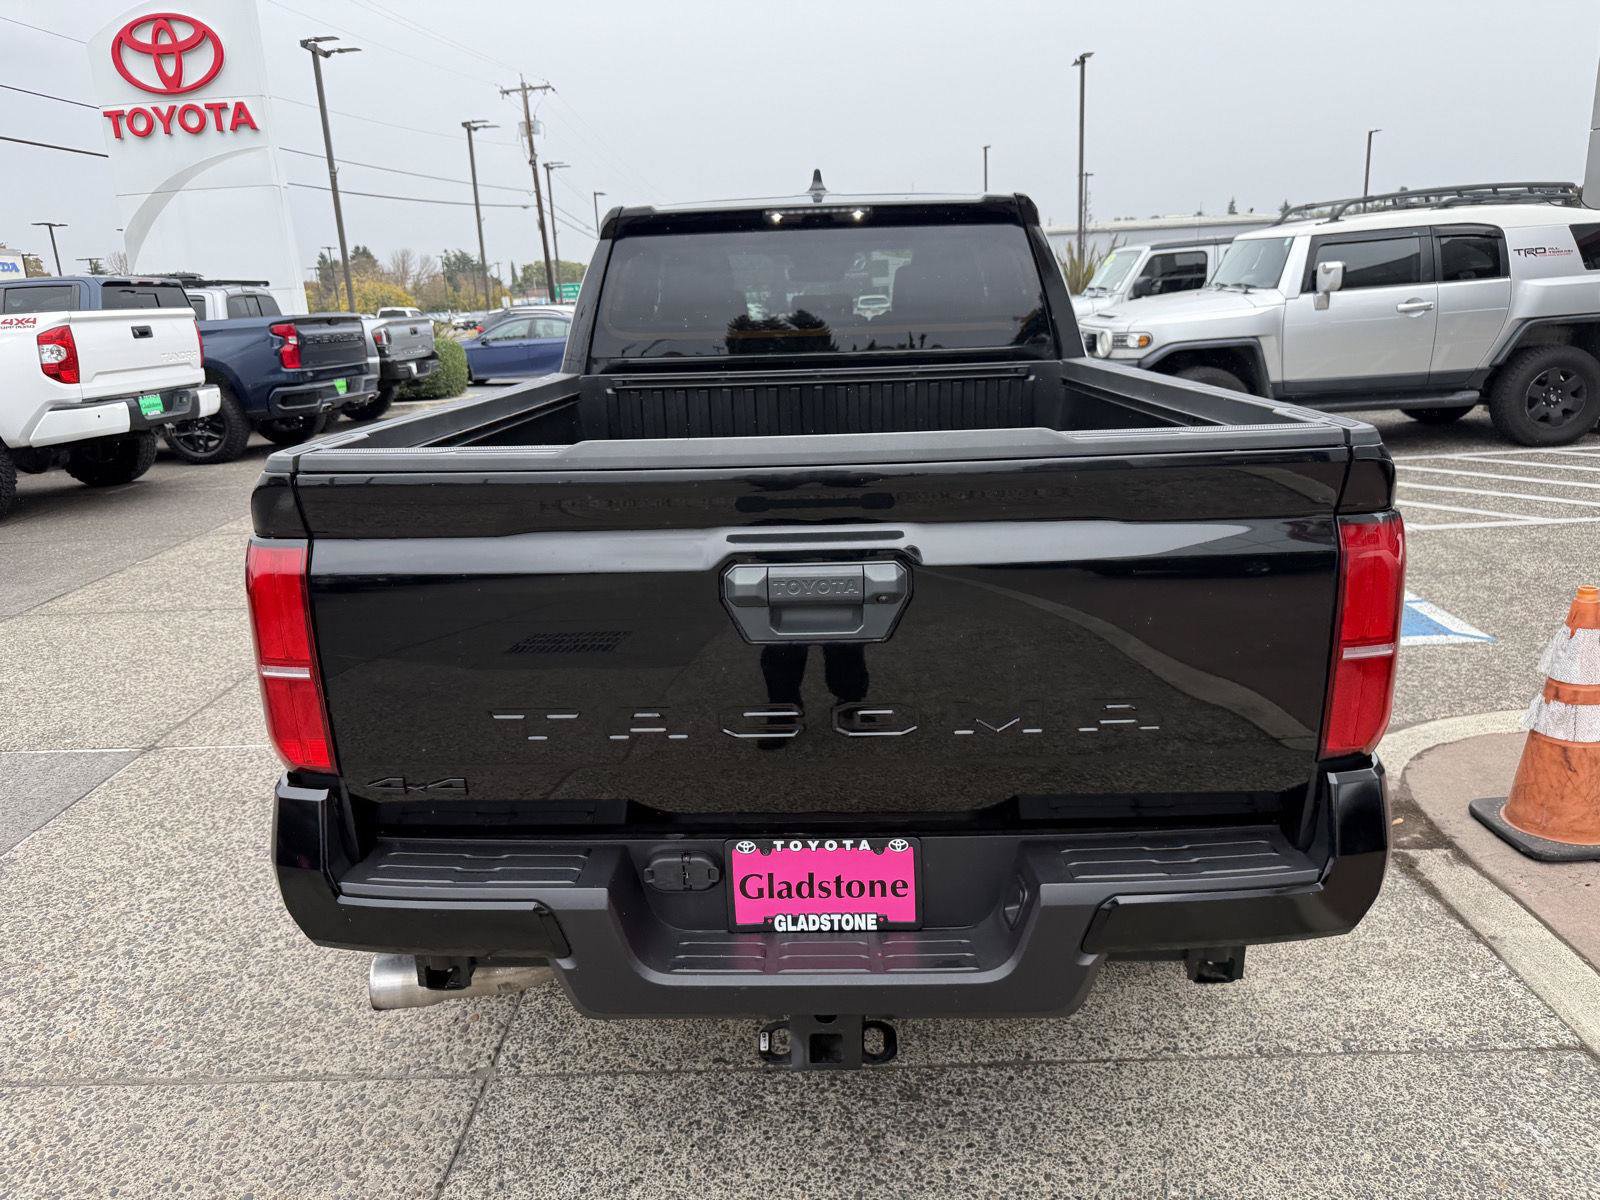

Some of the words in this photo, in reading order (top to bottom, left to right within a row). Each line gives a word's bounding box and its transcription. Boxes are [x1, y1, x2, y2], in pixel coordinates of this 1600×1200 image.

[103, 101, 259, 139] TOYOTA
[1513, 247, 1546, 257] TRD
[773, 578, 859, 596] TOYOTA
[491, 700, 1162, 743] TACOMA
[773, 840, 873, 851] TOYOTA
[739, 872, 909, 899] Gladstone
[774, 914, 878, 931] GLADSTONE
